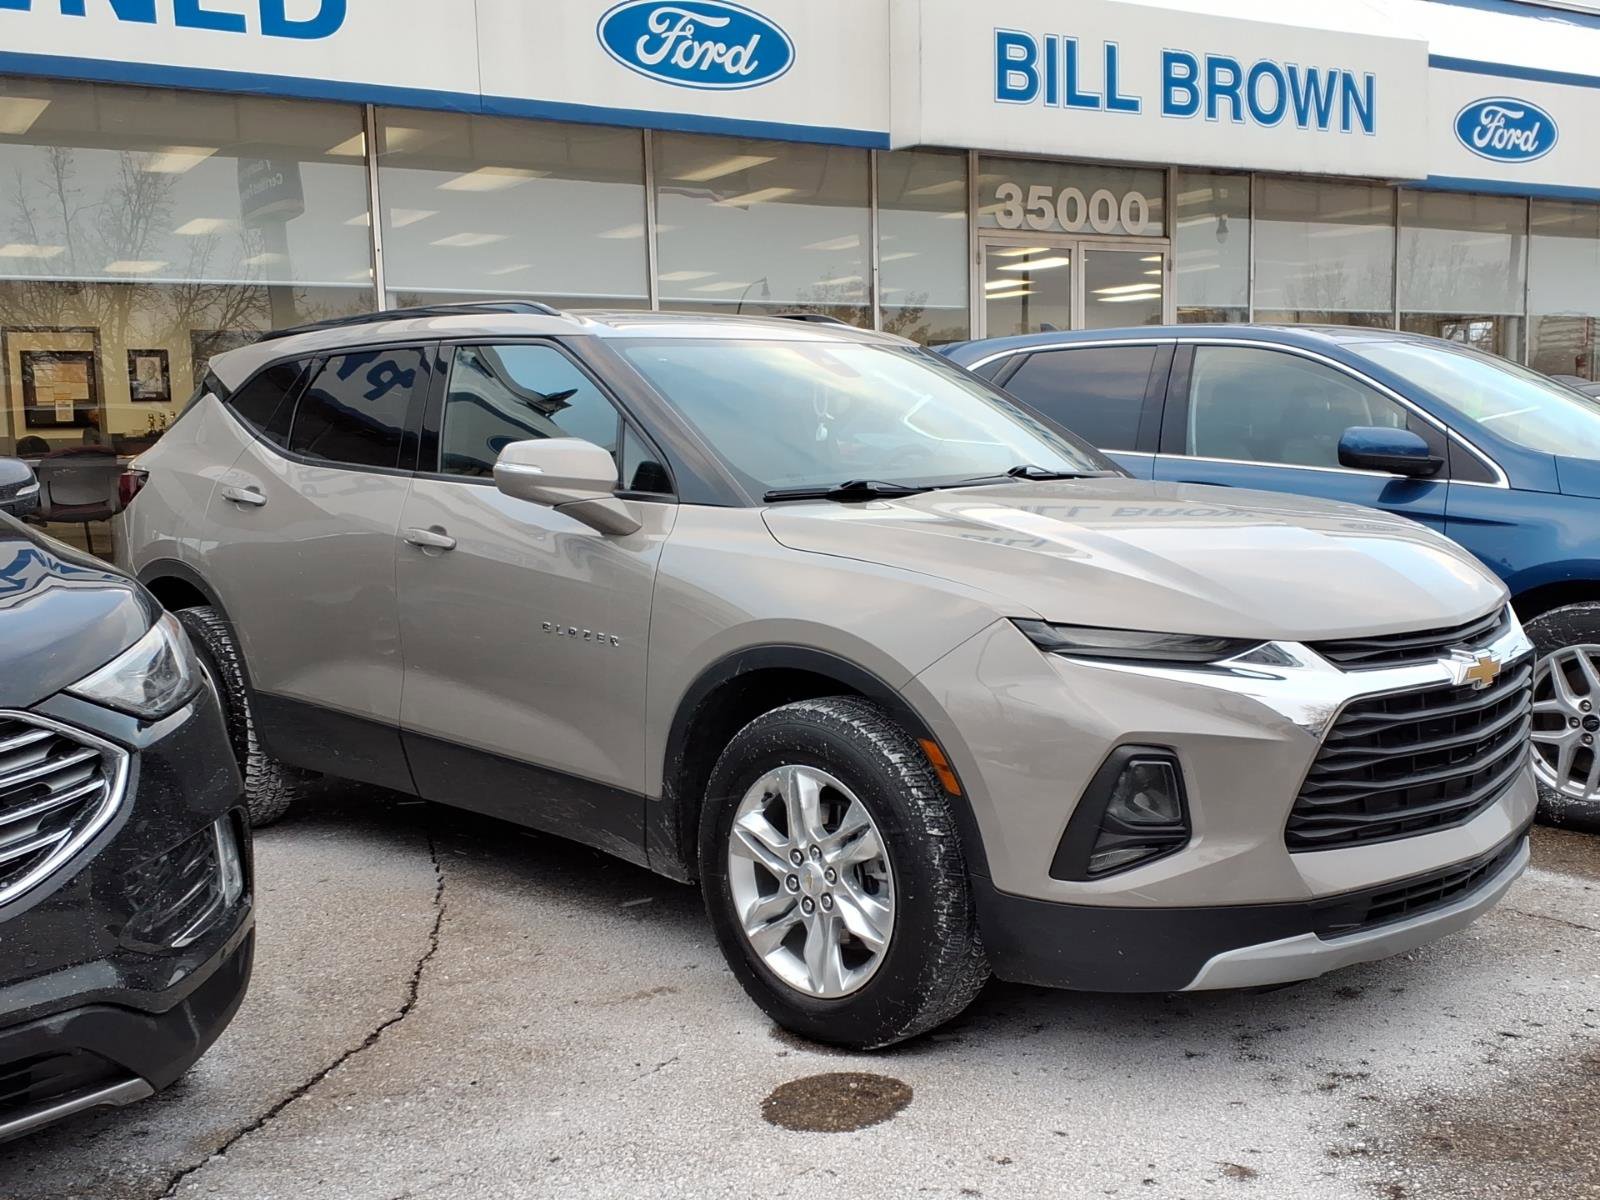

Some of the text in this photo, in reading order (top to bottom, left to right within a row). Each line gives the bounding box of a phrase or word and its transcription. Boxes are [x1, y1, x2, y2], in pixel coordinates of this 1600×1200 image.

[636, 6, 761, 76] Ford
[994, 27, 1376, 137] BILL BROWN
[1473, 105, 1540, 152] Ford
[994, 182, 1149, 235] 35000
[542, 621, 619, 647] BLAZER
